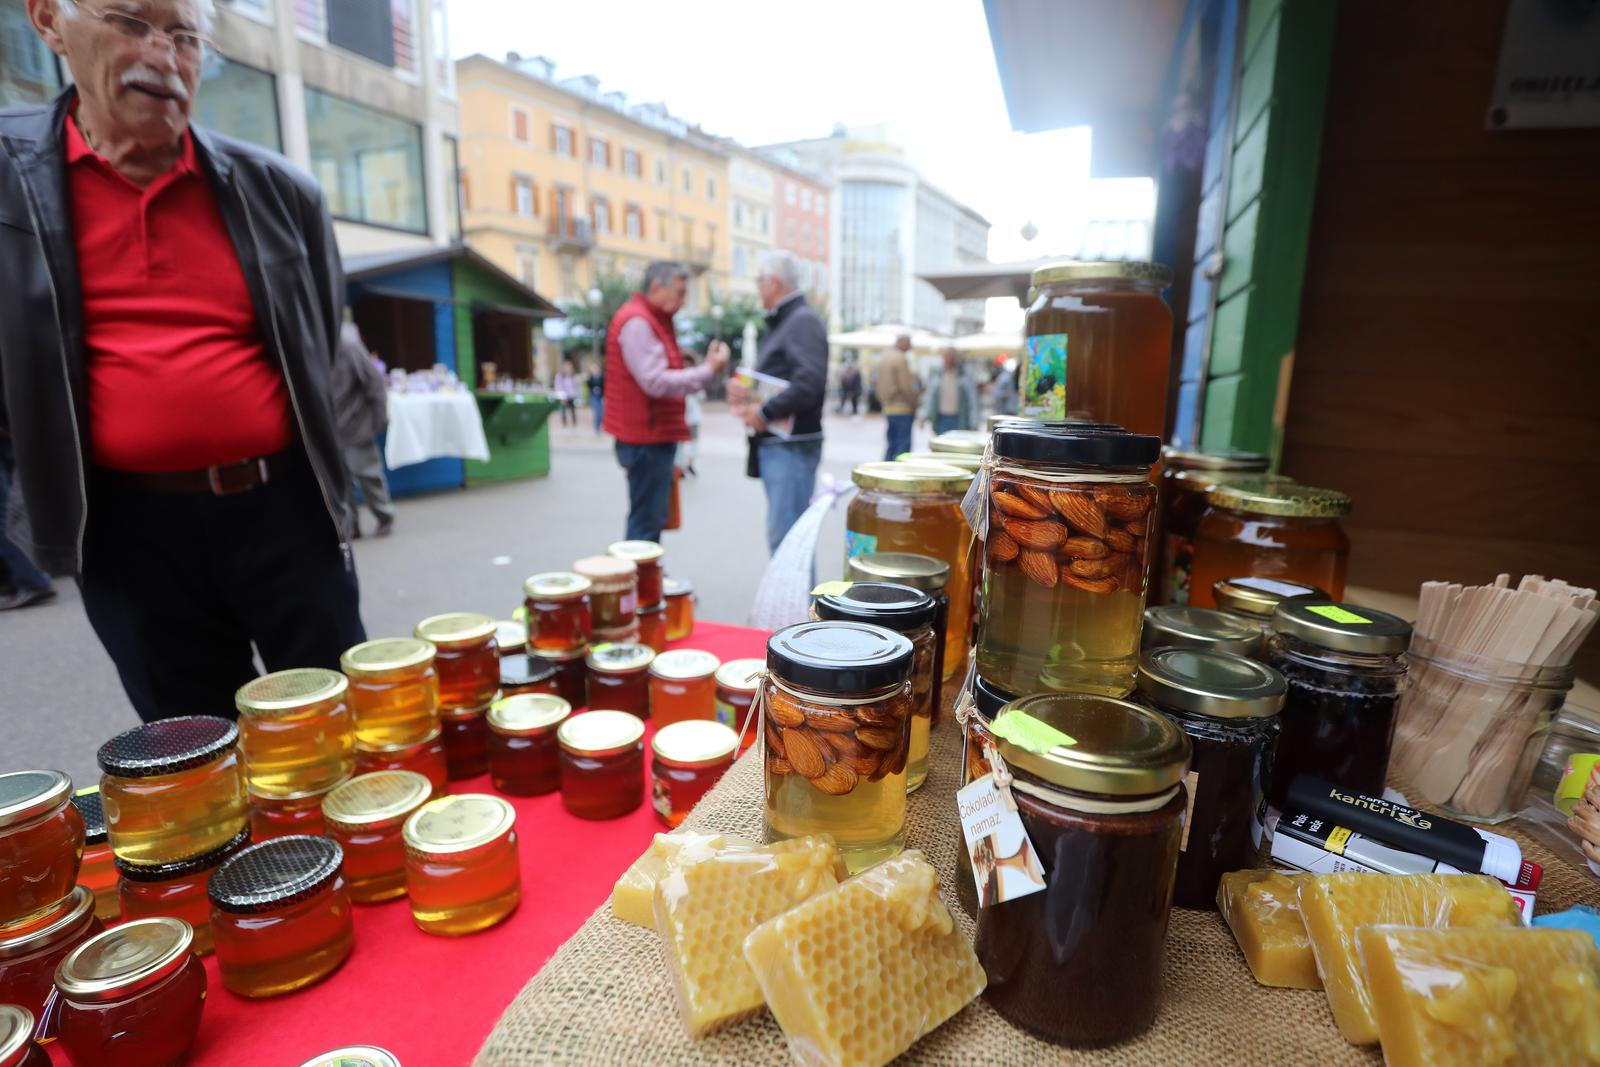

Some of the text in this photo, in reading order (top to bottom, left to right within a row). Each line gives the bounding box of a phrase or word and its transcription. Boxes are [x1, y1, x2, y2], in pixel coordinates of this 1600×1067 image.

[959, 789, 997, 820] Čokolad
[1359, 795, 1414, 814] caffe bar
[970, 812, 1001, 837] namaz
